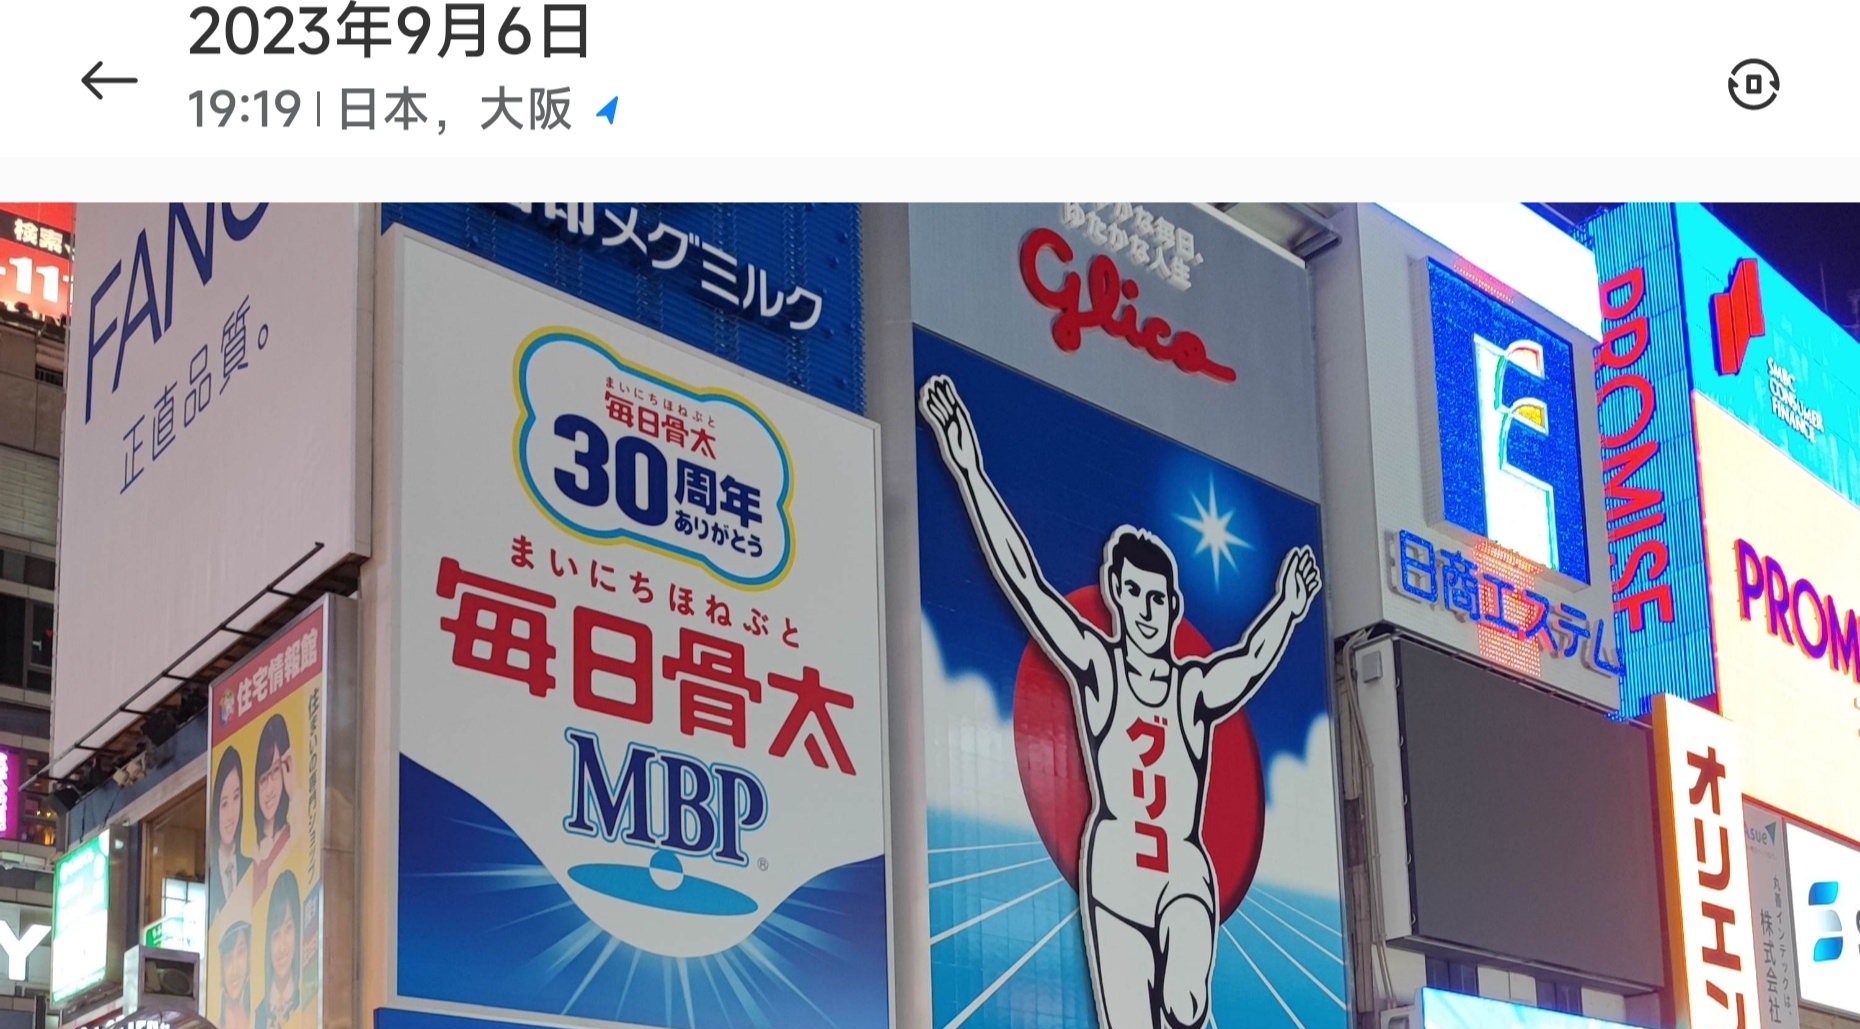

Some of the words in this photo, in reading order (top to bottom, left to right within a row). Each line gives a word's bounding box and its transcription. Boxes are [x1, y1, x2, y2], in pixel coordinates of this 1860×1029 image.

[14, 218, 63, 254] 検索
[509, 203, 823, 330] メグミルク
[85, 203, 270, 425] FAN
[1020, 228, 1237, 383] Glico
[120, 295, 269, 494] 正直品質。
[604, 391, 717, 460] 毎日骨太
[1767, 357, 1796, 393] SMBC
[1769, 377, 1825, 434] CONSUMER
[1771, 395, 1817, 445] FINANCE
[674, 510, 763, 558] ありがとう
[511, 535, 800, 648] まいにちほねぶと
[237, 627, 319, 717] 住宅情報館
[436, 557, 857, 775] 毎日骨太
[564, 729, 768, 866] MBP
[1126, 715, 1169, 873] グリコ
[1760, 909, 1782, 1023] 株式会社
